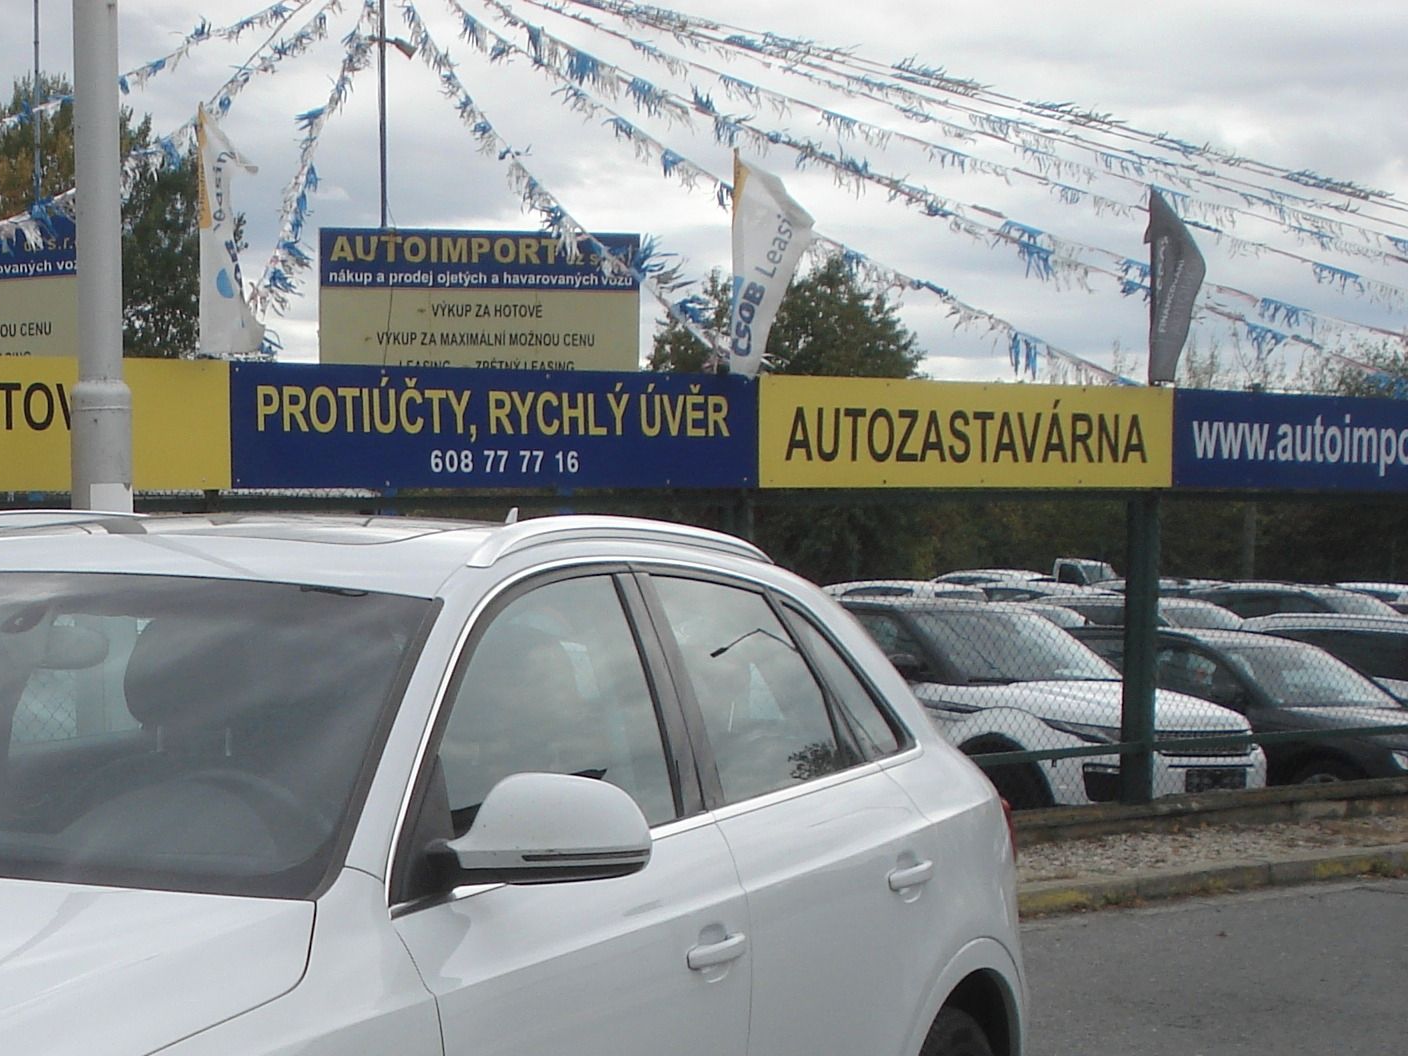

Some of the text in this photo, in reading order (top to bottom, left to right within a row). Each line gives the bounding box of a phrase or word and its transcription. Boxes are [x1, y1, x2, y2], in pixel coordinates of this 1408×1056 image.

[329, 235, 558, 266] AUTOIMPORT
[755, 213, 793, 280] Leasi
[328, 268, 373, 285] nákup
[376, 271, 386, 283] a
[389, 269, 434, 287] prodej
[437, 270, 488, 288] ojetých
[491, 273, 500, 285] a
[503, 271, 599, 288] havarovaných
[431, 300, 472, 318] VÝKUP
[475, 303, 491, 318] ZA
[19, 320, 53, 338] CENU
[420, 331, 437, 346] ZA
[440, 329, 506, 347] MAXIMÁLNÍ
[509, 329, 561, 347] MOŽNOU
[563, 332, 596, 348] CENU
[255, 376, 731, 443] PROTIÚČTY, RYCHLÝ ÚVĚR
[784, 398, 1148, 464] AUTOZASTAVÁRNA
[429, 449, 580, 474] 608 77 77 16
